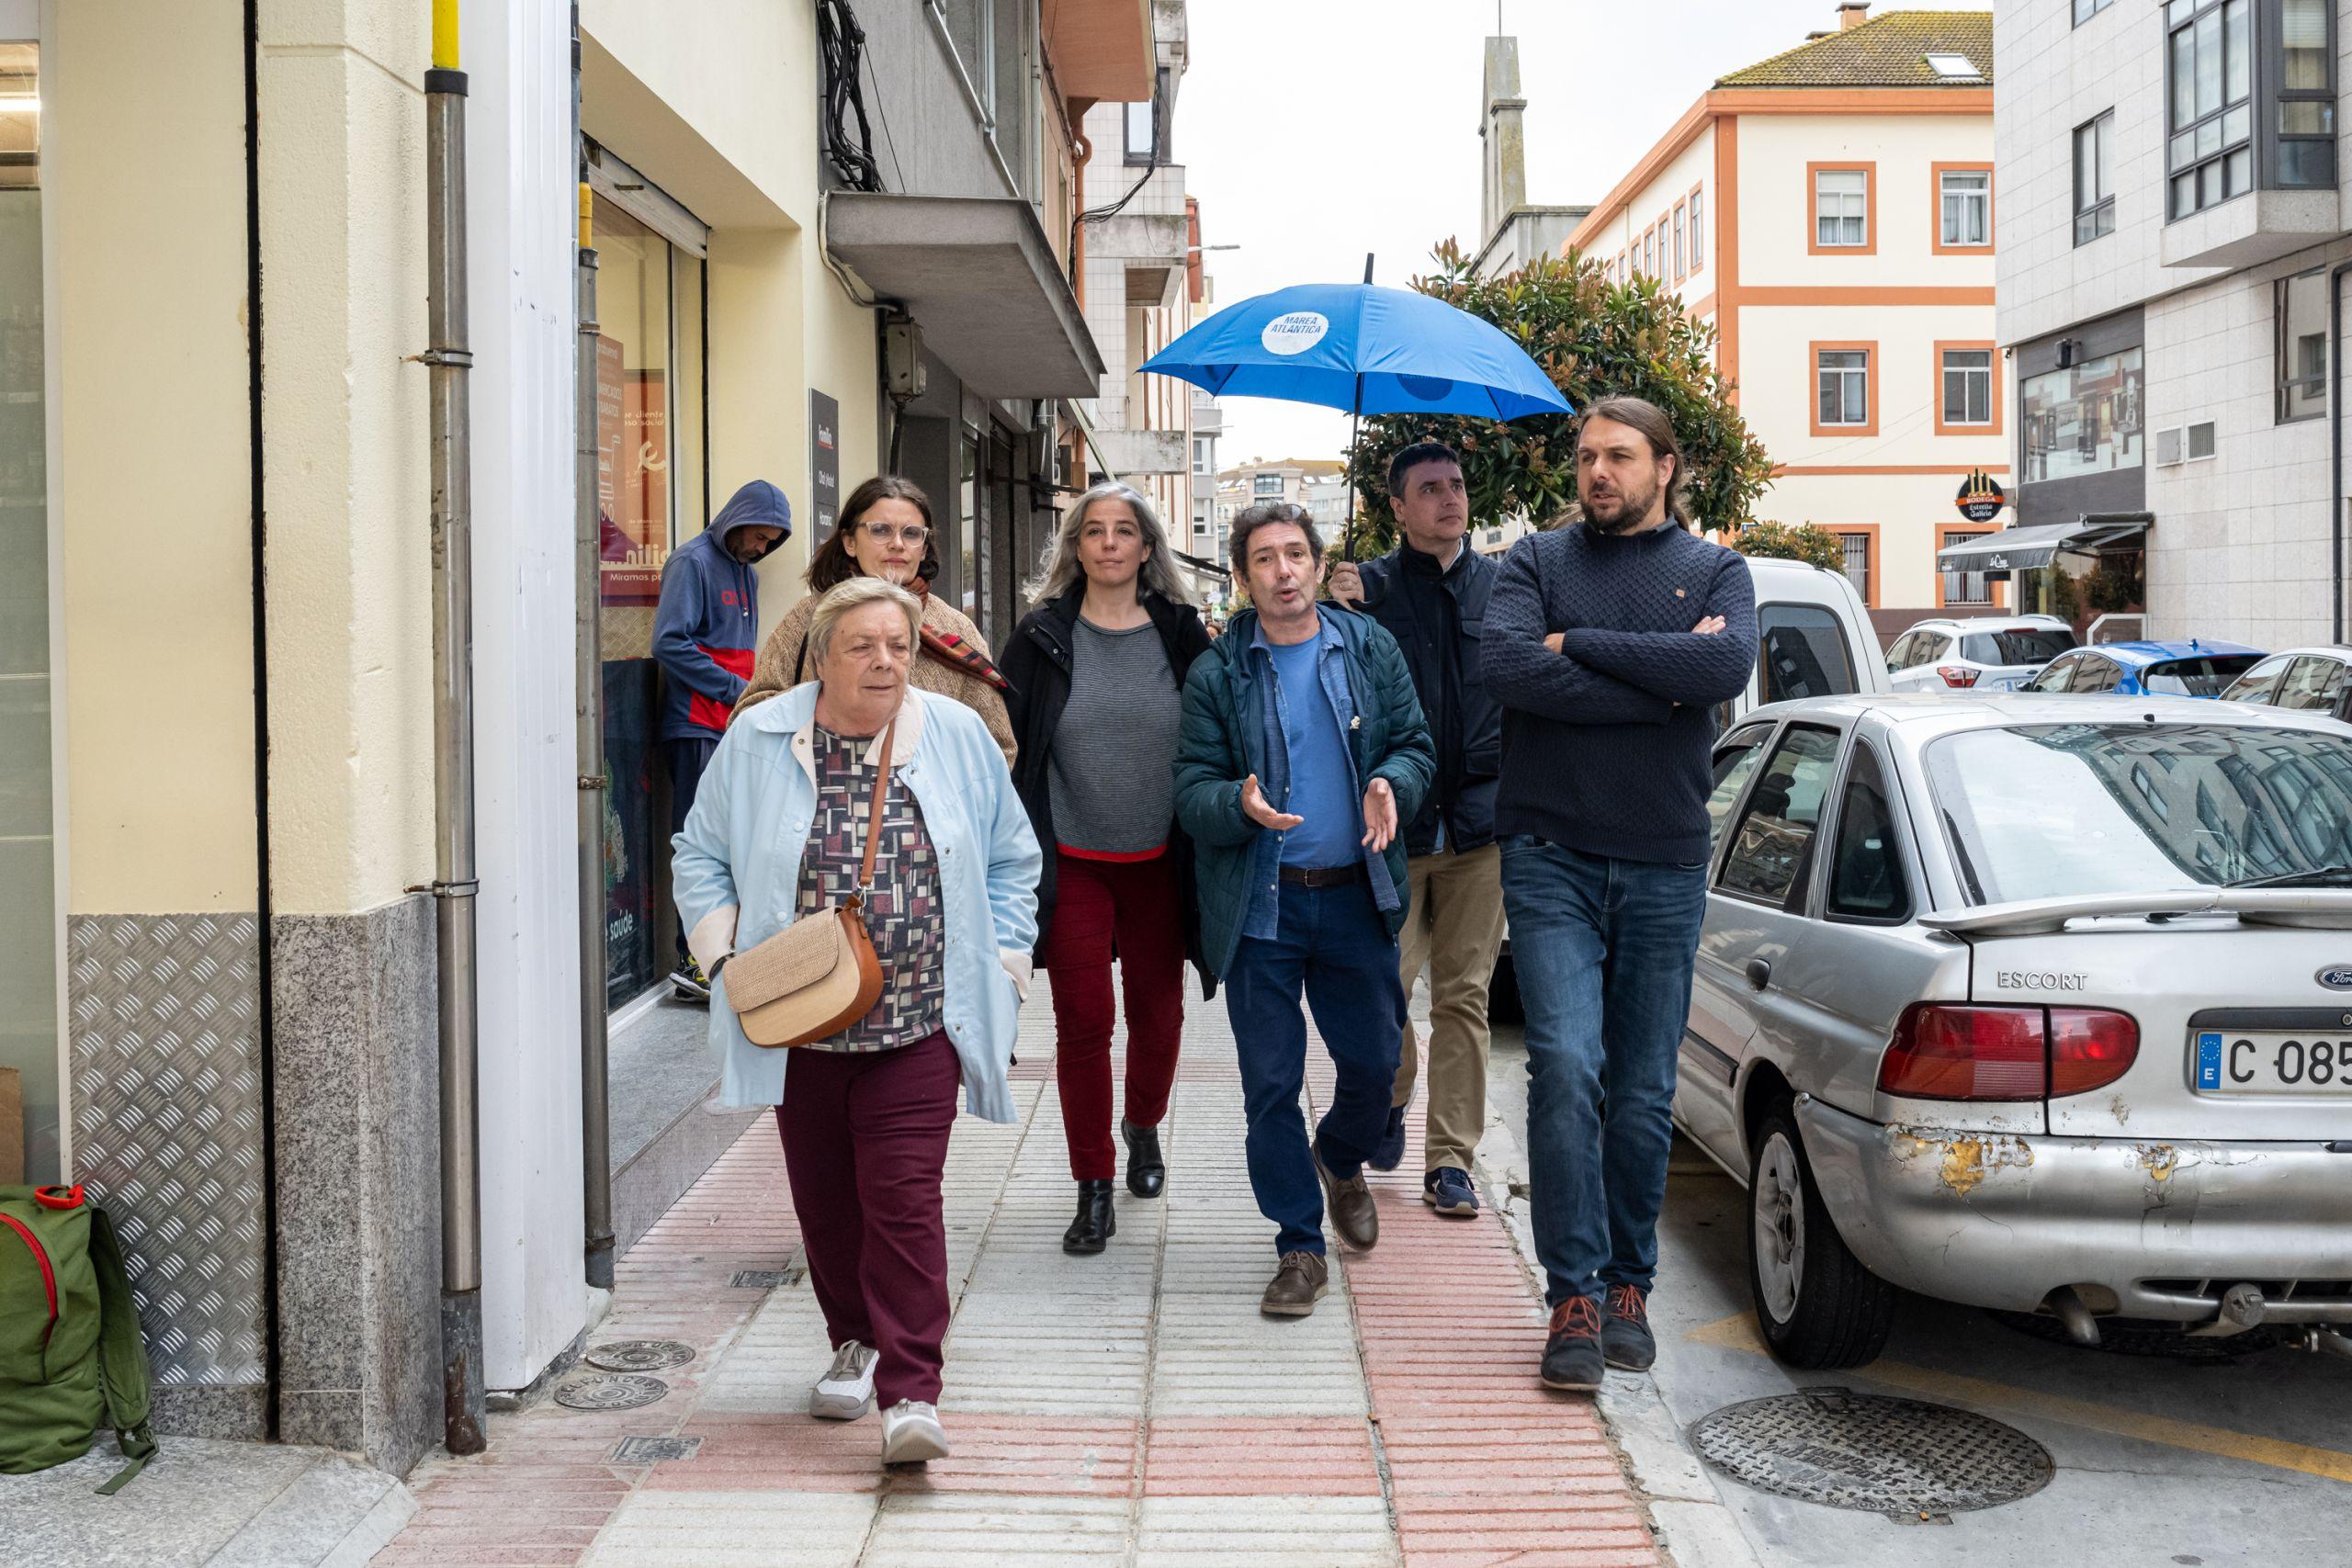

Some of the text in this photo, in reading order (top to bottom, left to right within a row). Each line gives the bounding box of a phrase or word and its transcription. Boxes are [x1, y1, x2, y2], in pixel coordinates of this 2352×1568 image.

[635, 410, 663, 418] cliente
[610, 573, 649, 581] Miramos
[610, 908, 633, 942] saúde
[1997, 971, 2087, 990] ESCORT
[2229, 1039, 2256, 1083] C
[2204, 1067, 2215, 1080] E
